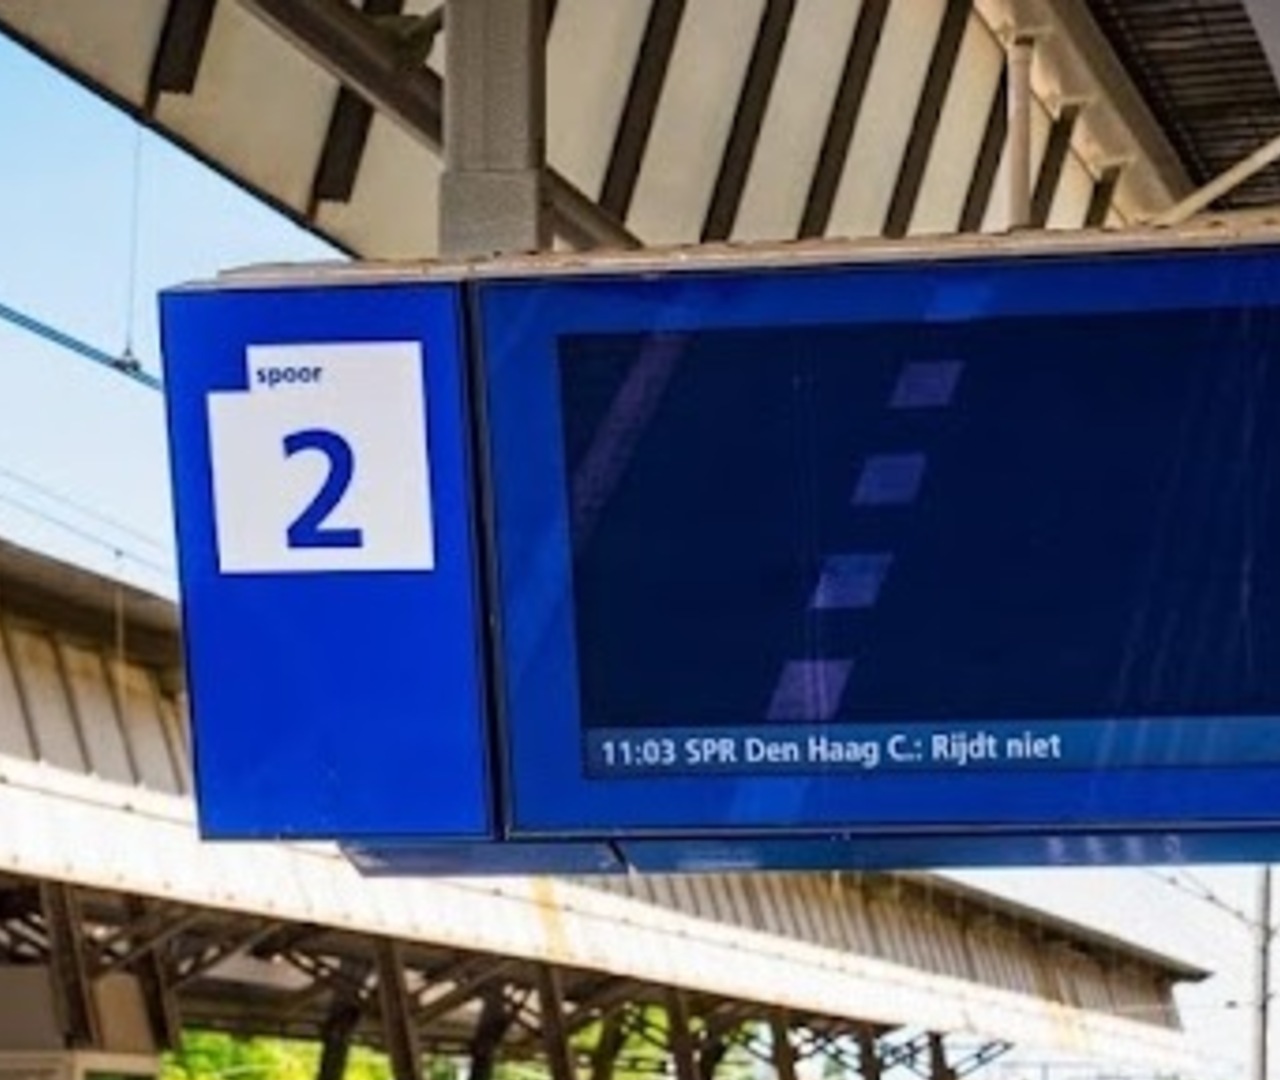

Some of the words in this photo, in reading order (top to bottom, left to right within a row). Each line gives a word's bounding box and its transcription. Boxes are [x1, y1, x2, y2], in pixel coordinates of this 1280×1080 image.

[255, 367, 322, 387] spoor
[283, 427, 363, 549] 2
[602, 740, 676, 765] 11:03
[684, 738, 738, 764] SPR
[744, 737, 799, 762] Den
[807, 735, 880, 769] Haag
[887, 734, 922, 762] C.:
[931, 731, 998, 766] Rijdt
[1006, 731, 1062, 759] niet
